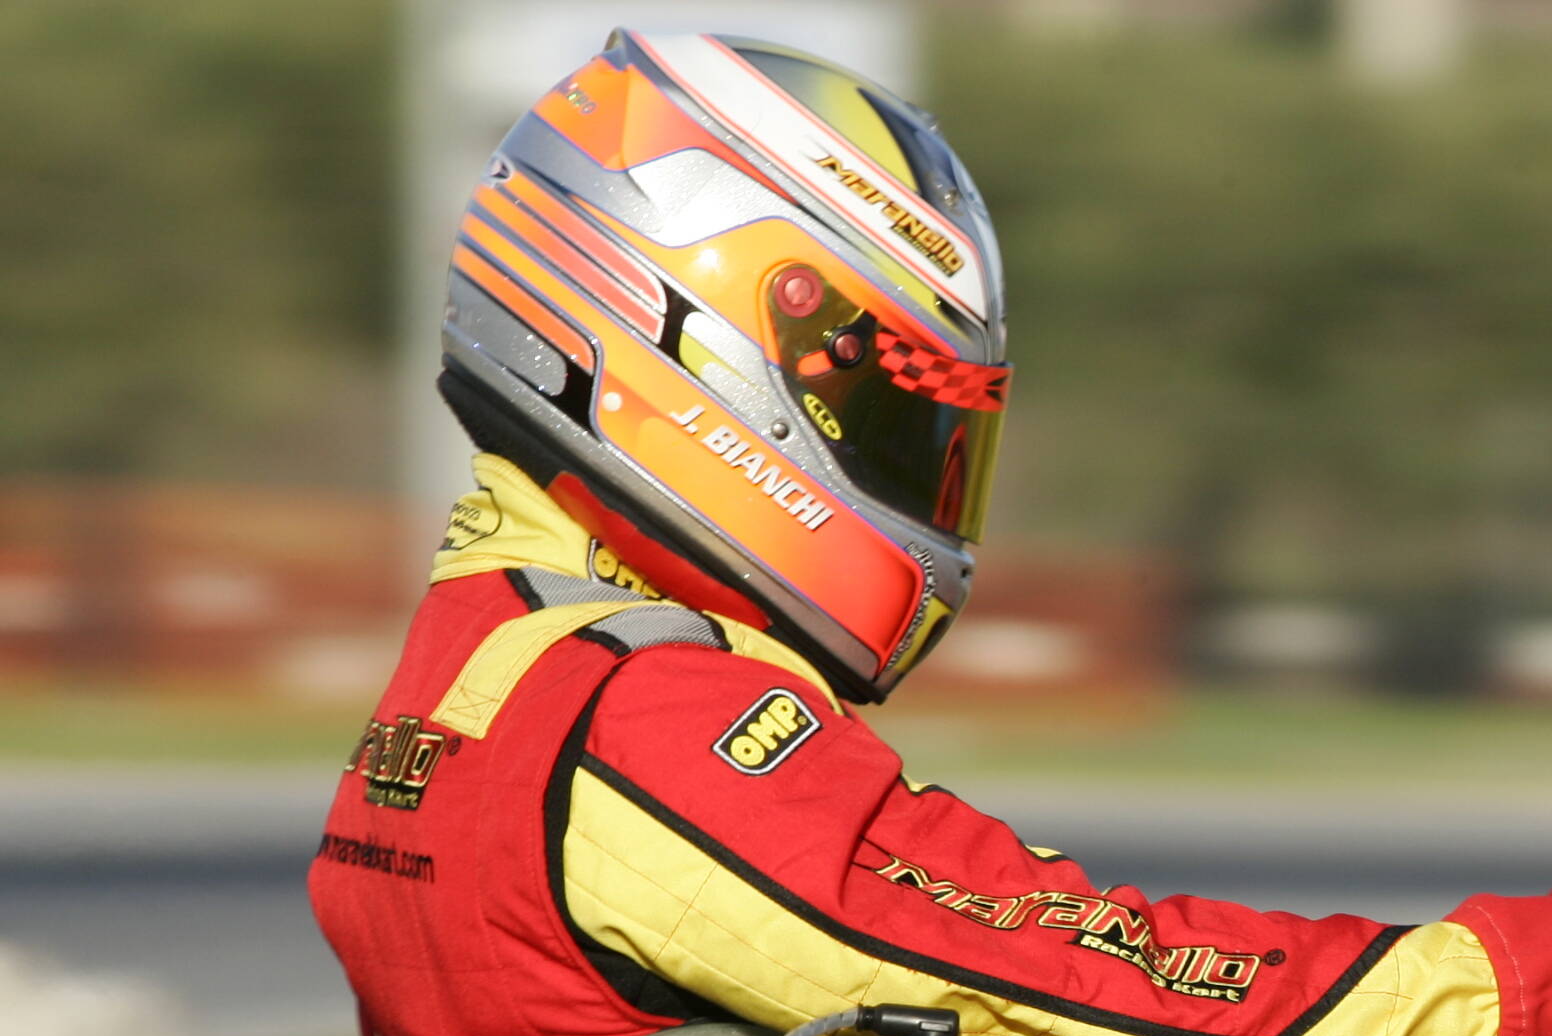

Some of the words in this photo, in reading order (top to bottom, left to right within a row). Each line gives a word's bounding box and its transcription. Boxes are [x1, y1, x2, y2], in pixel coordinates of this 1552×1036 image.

[669, 404, 706, 434] J.
[701, 424, 835, 531] BIANCHI
[730, 696, 798, 766] OMP
[875, 854, 1260, 988] Maranello
[1172, 982, 1240, 1003] Kart
